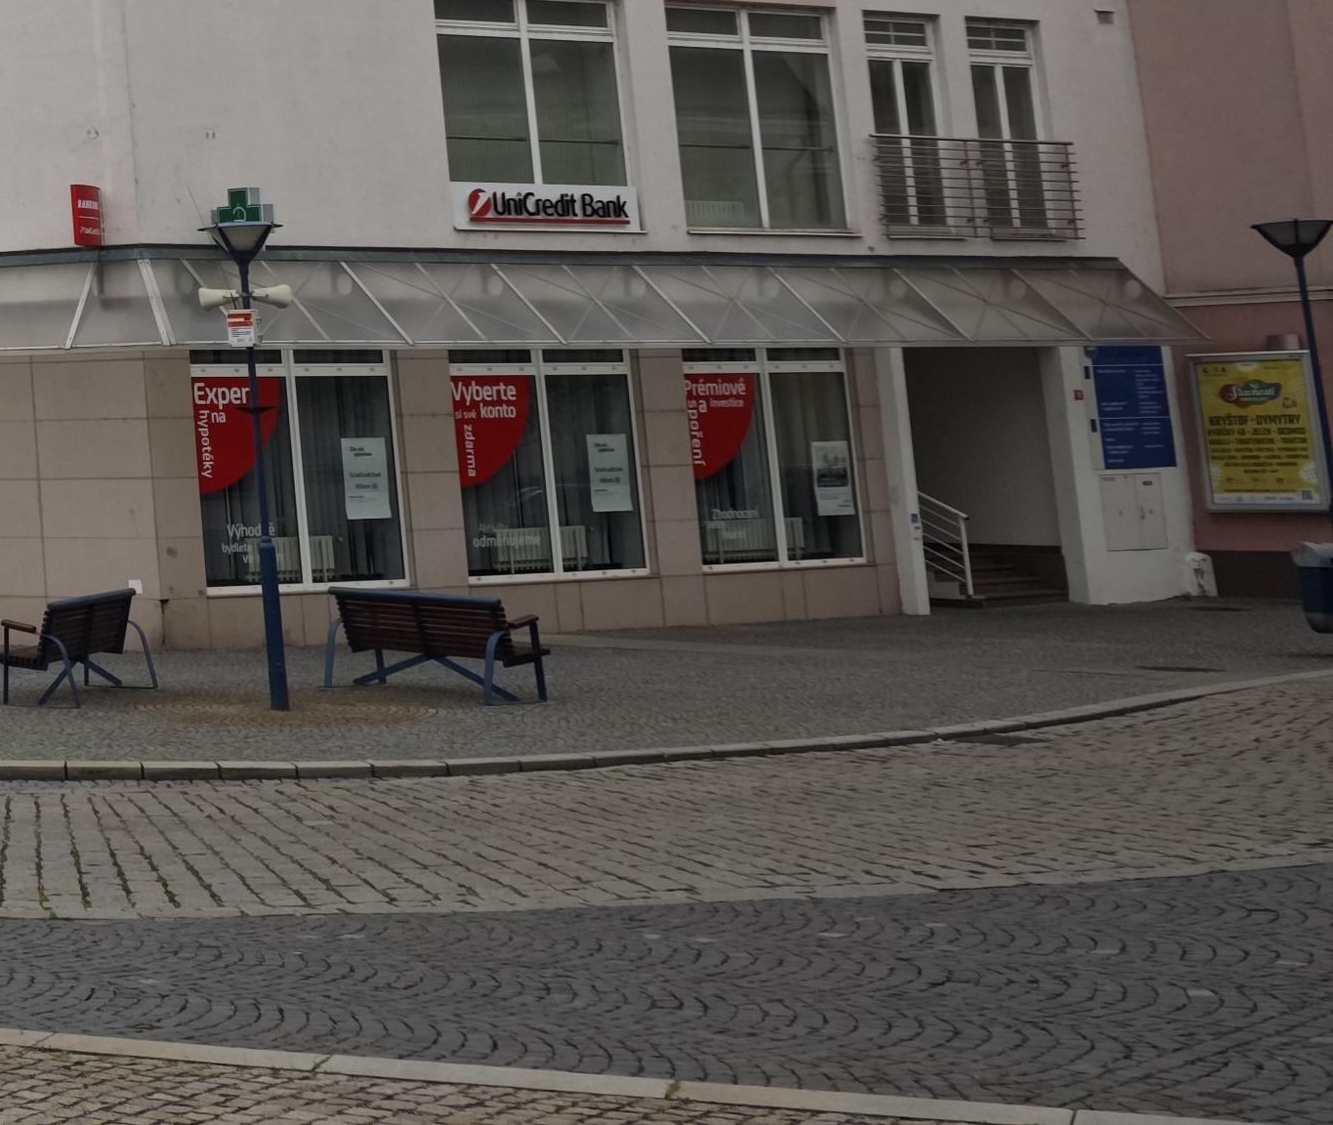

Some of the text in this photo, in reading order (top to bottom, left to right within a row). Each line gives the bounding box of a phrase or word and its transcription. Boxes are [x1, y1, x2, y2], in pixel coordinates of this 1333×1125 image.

[493, 192, 629, 218] UniCredit Bank
[194, 382, 250, 410] Exper
[450, 381, 517, 406] Vyberte
[685, 378, 747, 396] Prémiové
[212, 411, 226, 424] na
[480, 402, 517, 418] konto
[698, 399, 708, 413] a
[197, 410, 213, 479] hypotéky
[687, 400, 707, 466] spoření
[464, 424, 476, 477] zdarma
[226, 522, 276, 540] Výhodě
